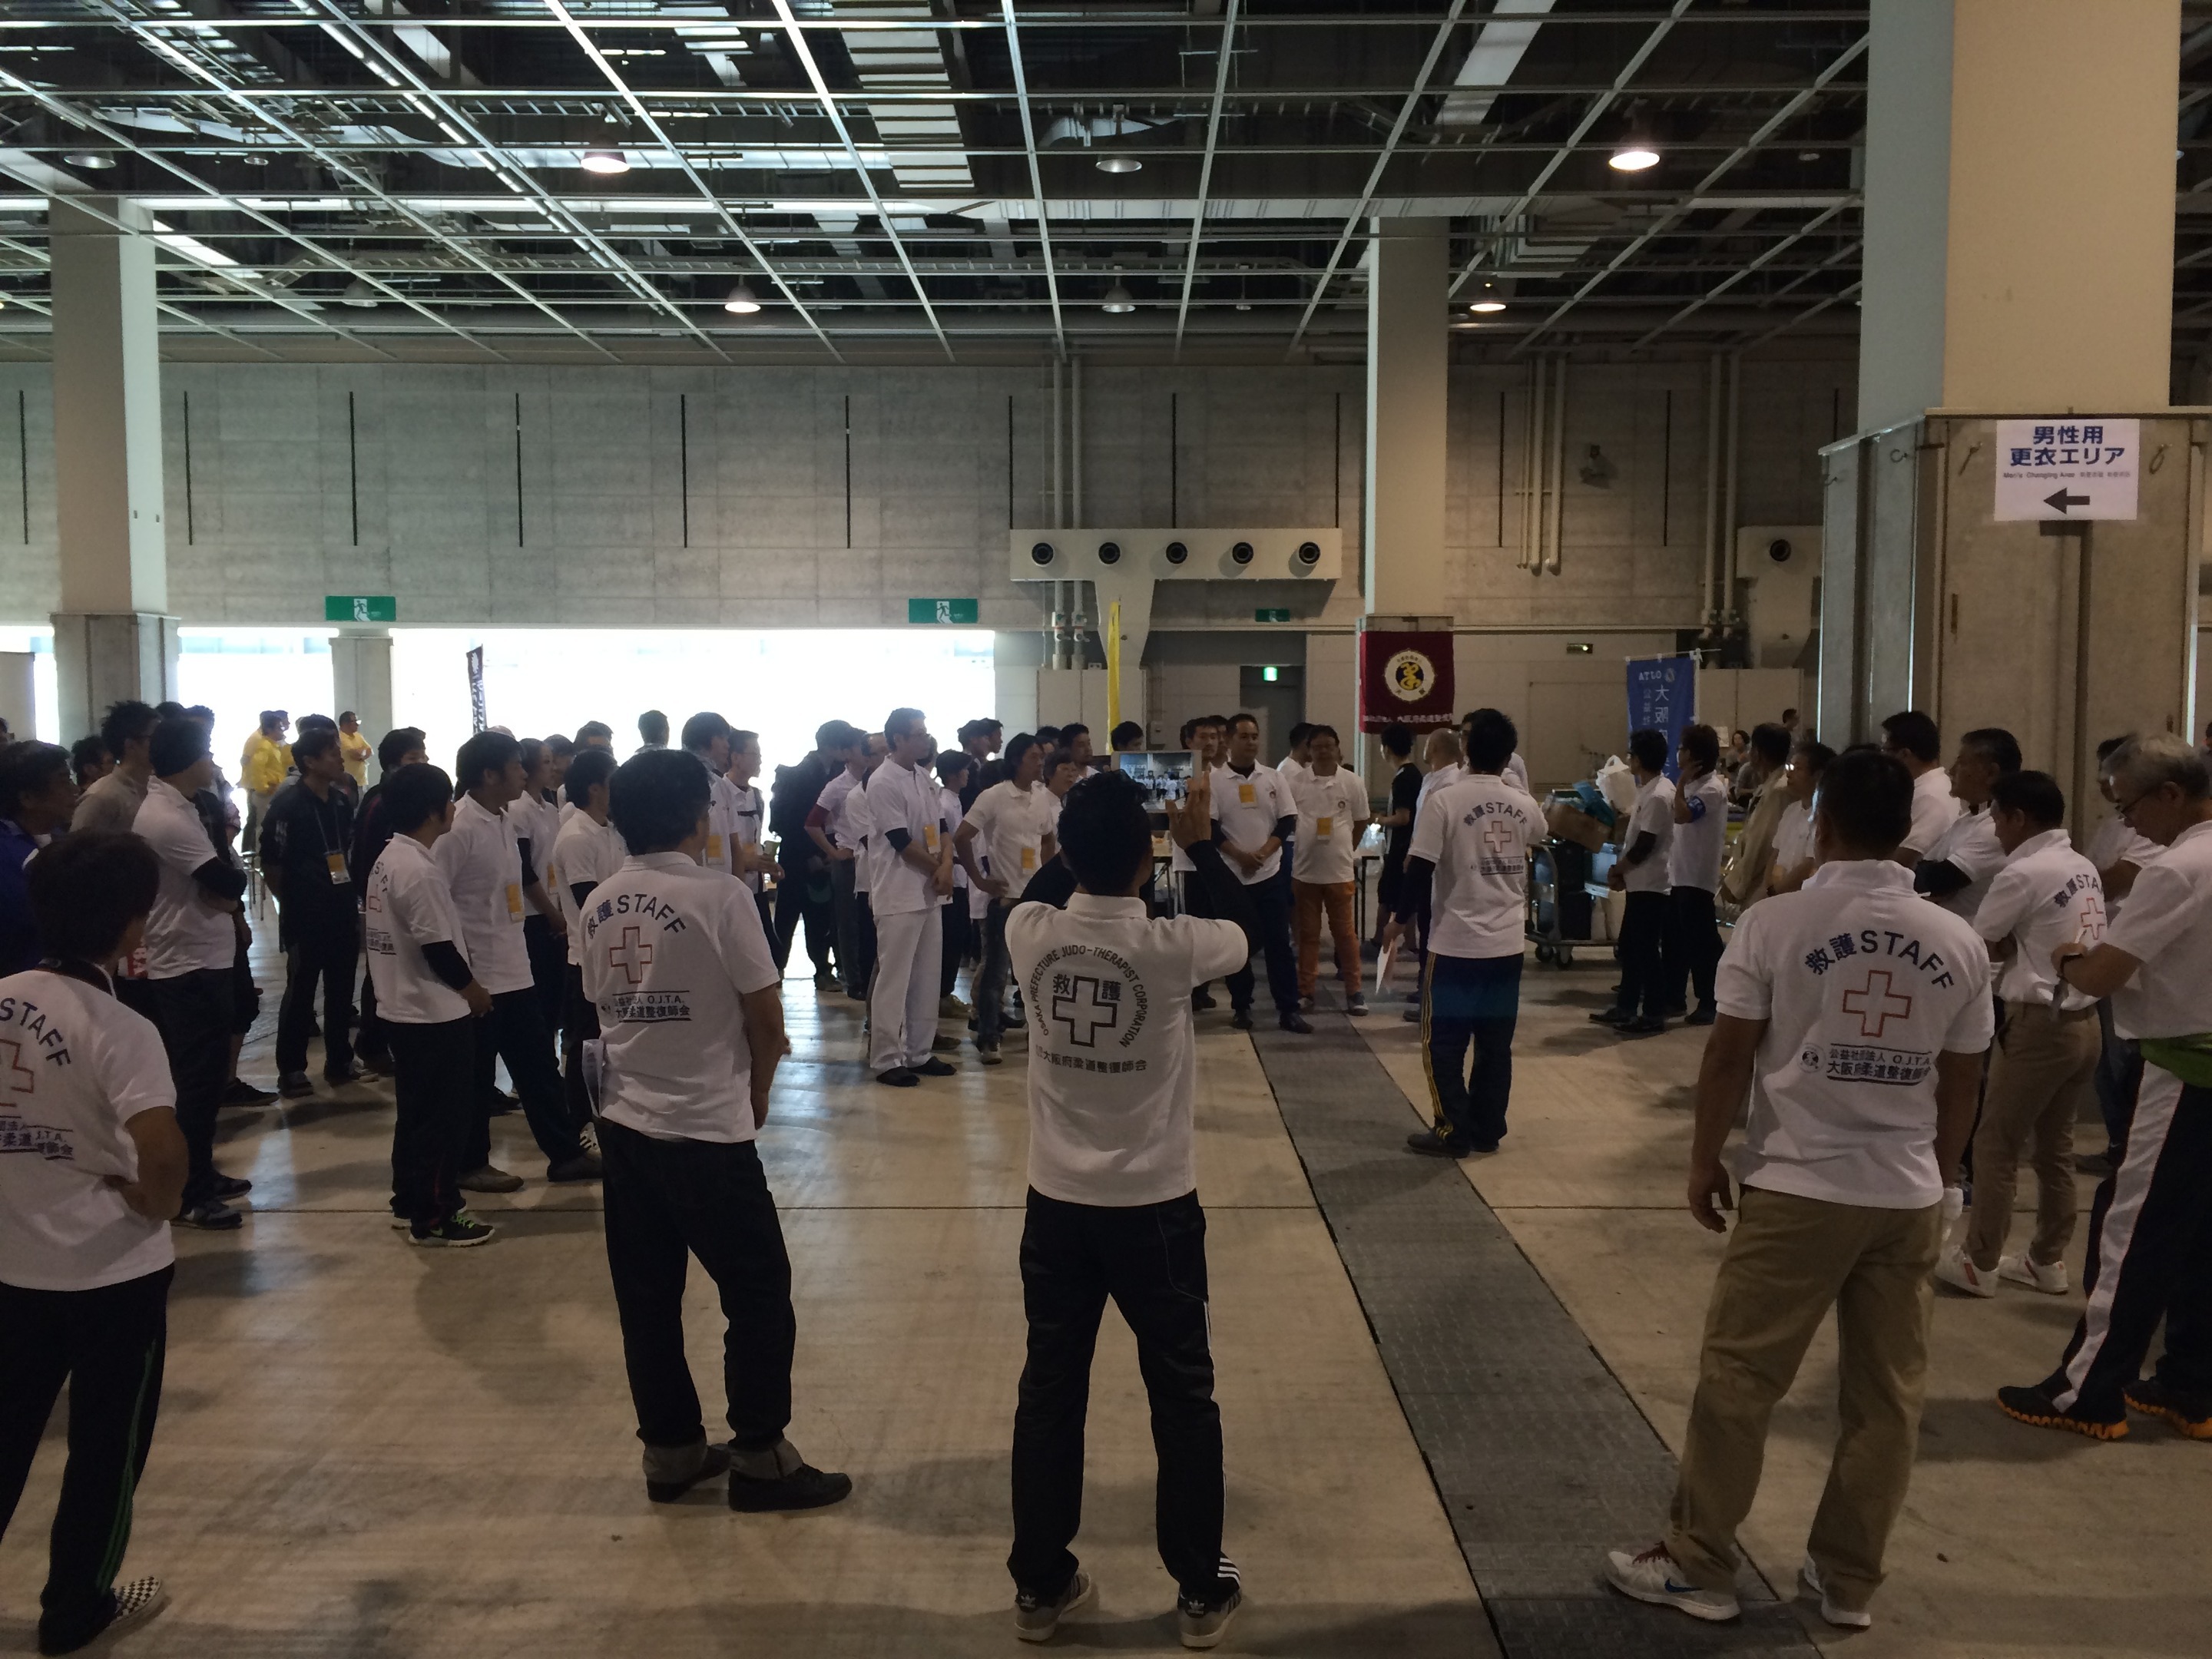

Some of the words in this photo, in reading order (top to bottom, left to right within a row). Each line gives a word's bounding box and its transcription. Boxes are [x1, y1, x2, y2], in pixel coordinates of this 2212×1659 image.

[2033, 425, 2104, 445] 男性用
[2010, 447, 2125, 466] 更衣エリア
[1029, 949, 1061, 1002] PREFECTURE
[1061, 945, 1139, 982] JUDO-THERAPIST
[1034, 1004, 1049, 1036] OSAKA
[1118, 984, 1147, 1048] CORPORATION
